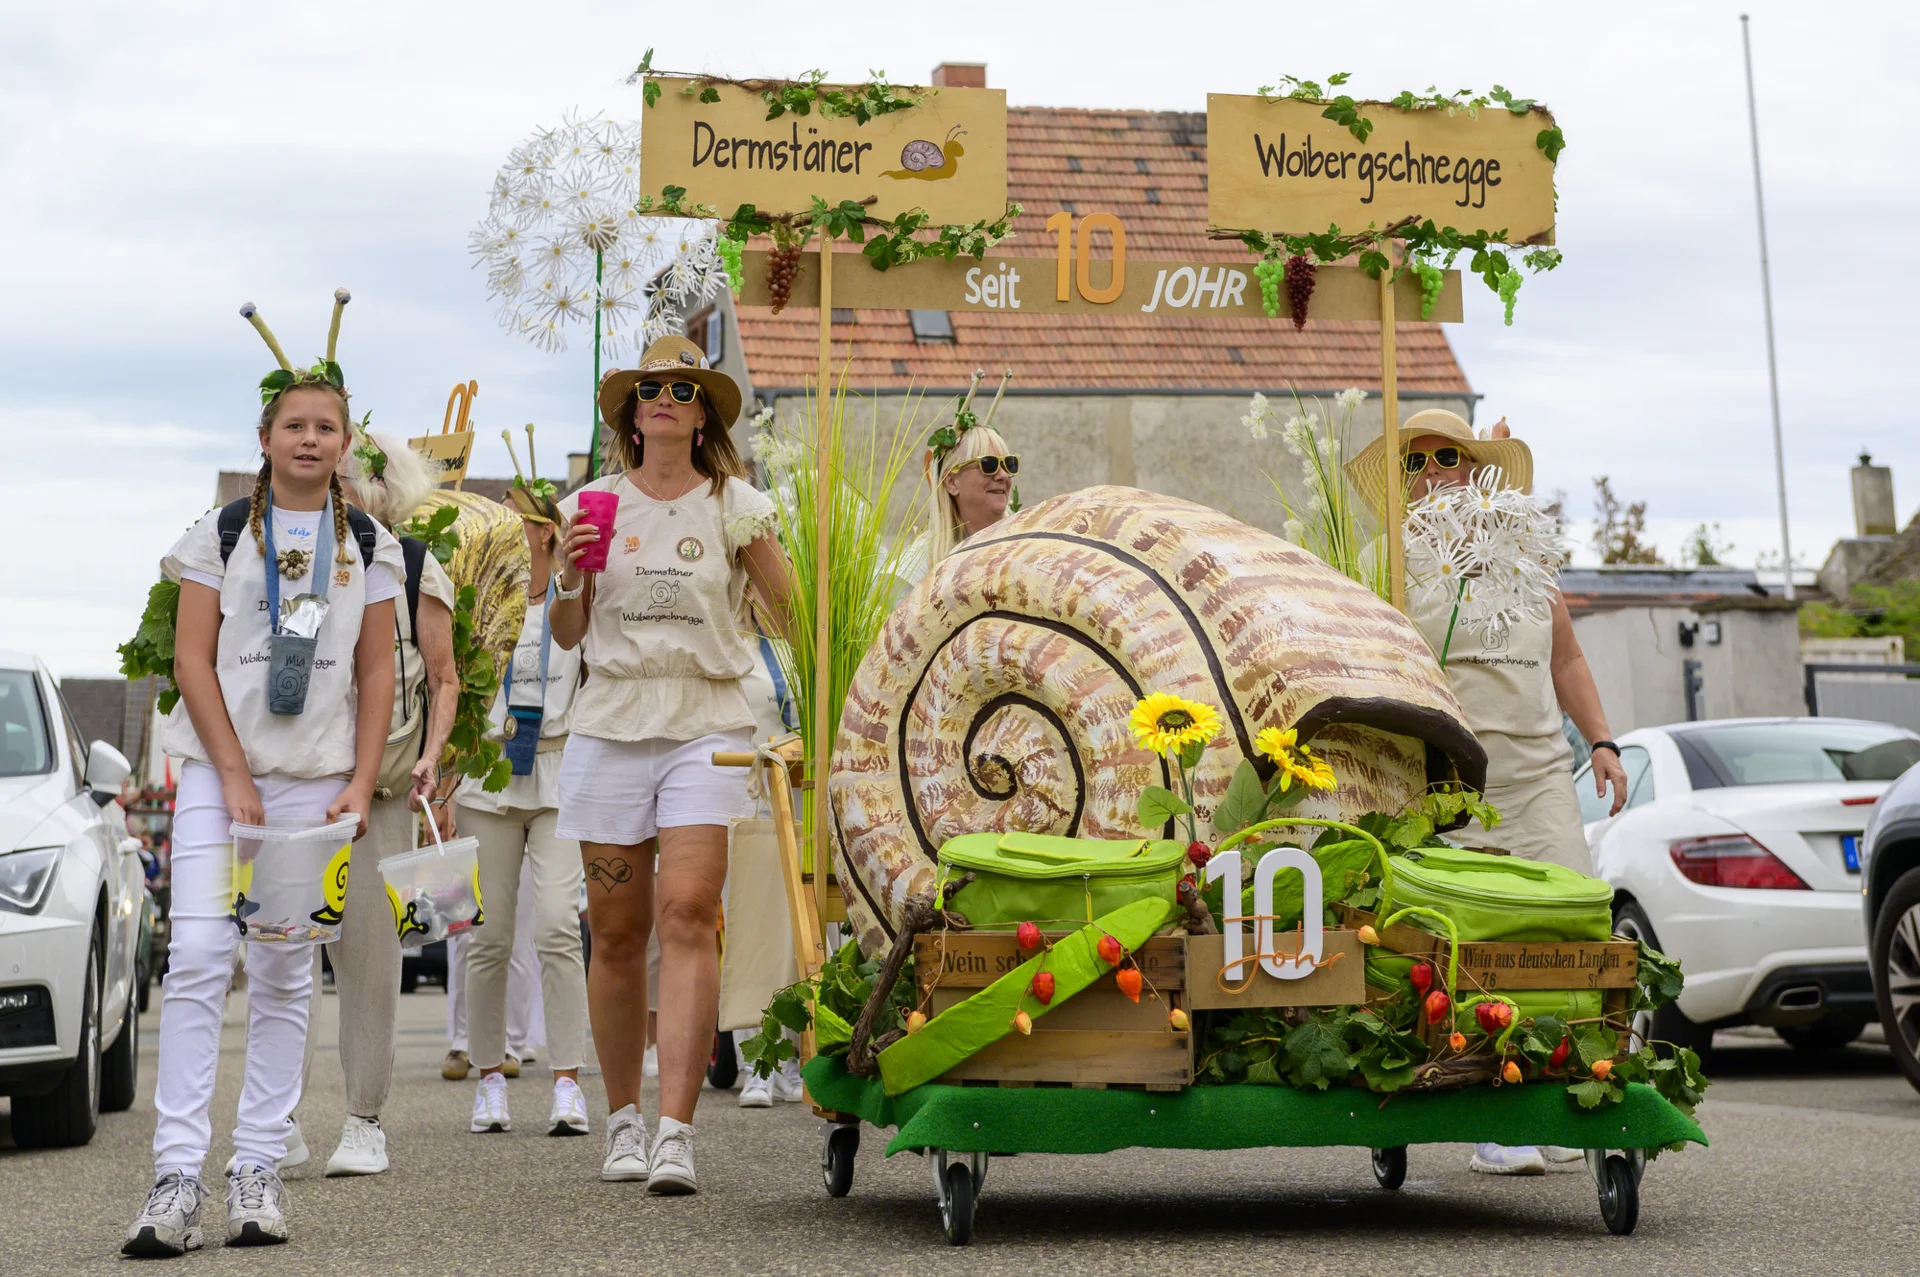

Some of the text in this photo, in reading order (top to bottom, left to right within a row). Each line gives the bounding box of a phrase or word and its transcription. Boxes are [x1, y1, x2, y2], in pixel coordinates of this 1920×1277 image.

[692, 120, 873, 176] Dermstäner
[1254, 133, 1502, 208] Woibergschnegge
[965, 211, 1248, 313] Seit 10 JOHR
[622, 612, 704, 626] Woibergschnegge
[285, 655, 306, 667] Mia
[1206, 847, 1323, 981] 10
[937, 950, 988, 973] Wein
[1463, 947, 1620, 969] Wein aus deutschen Landen
[1481, 972, 1497, 988] 76
